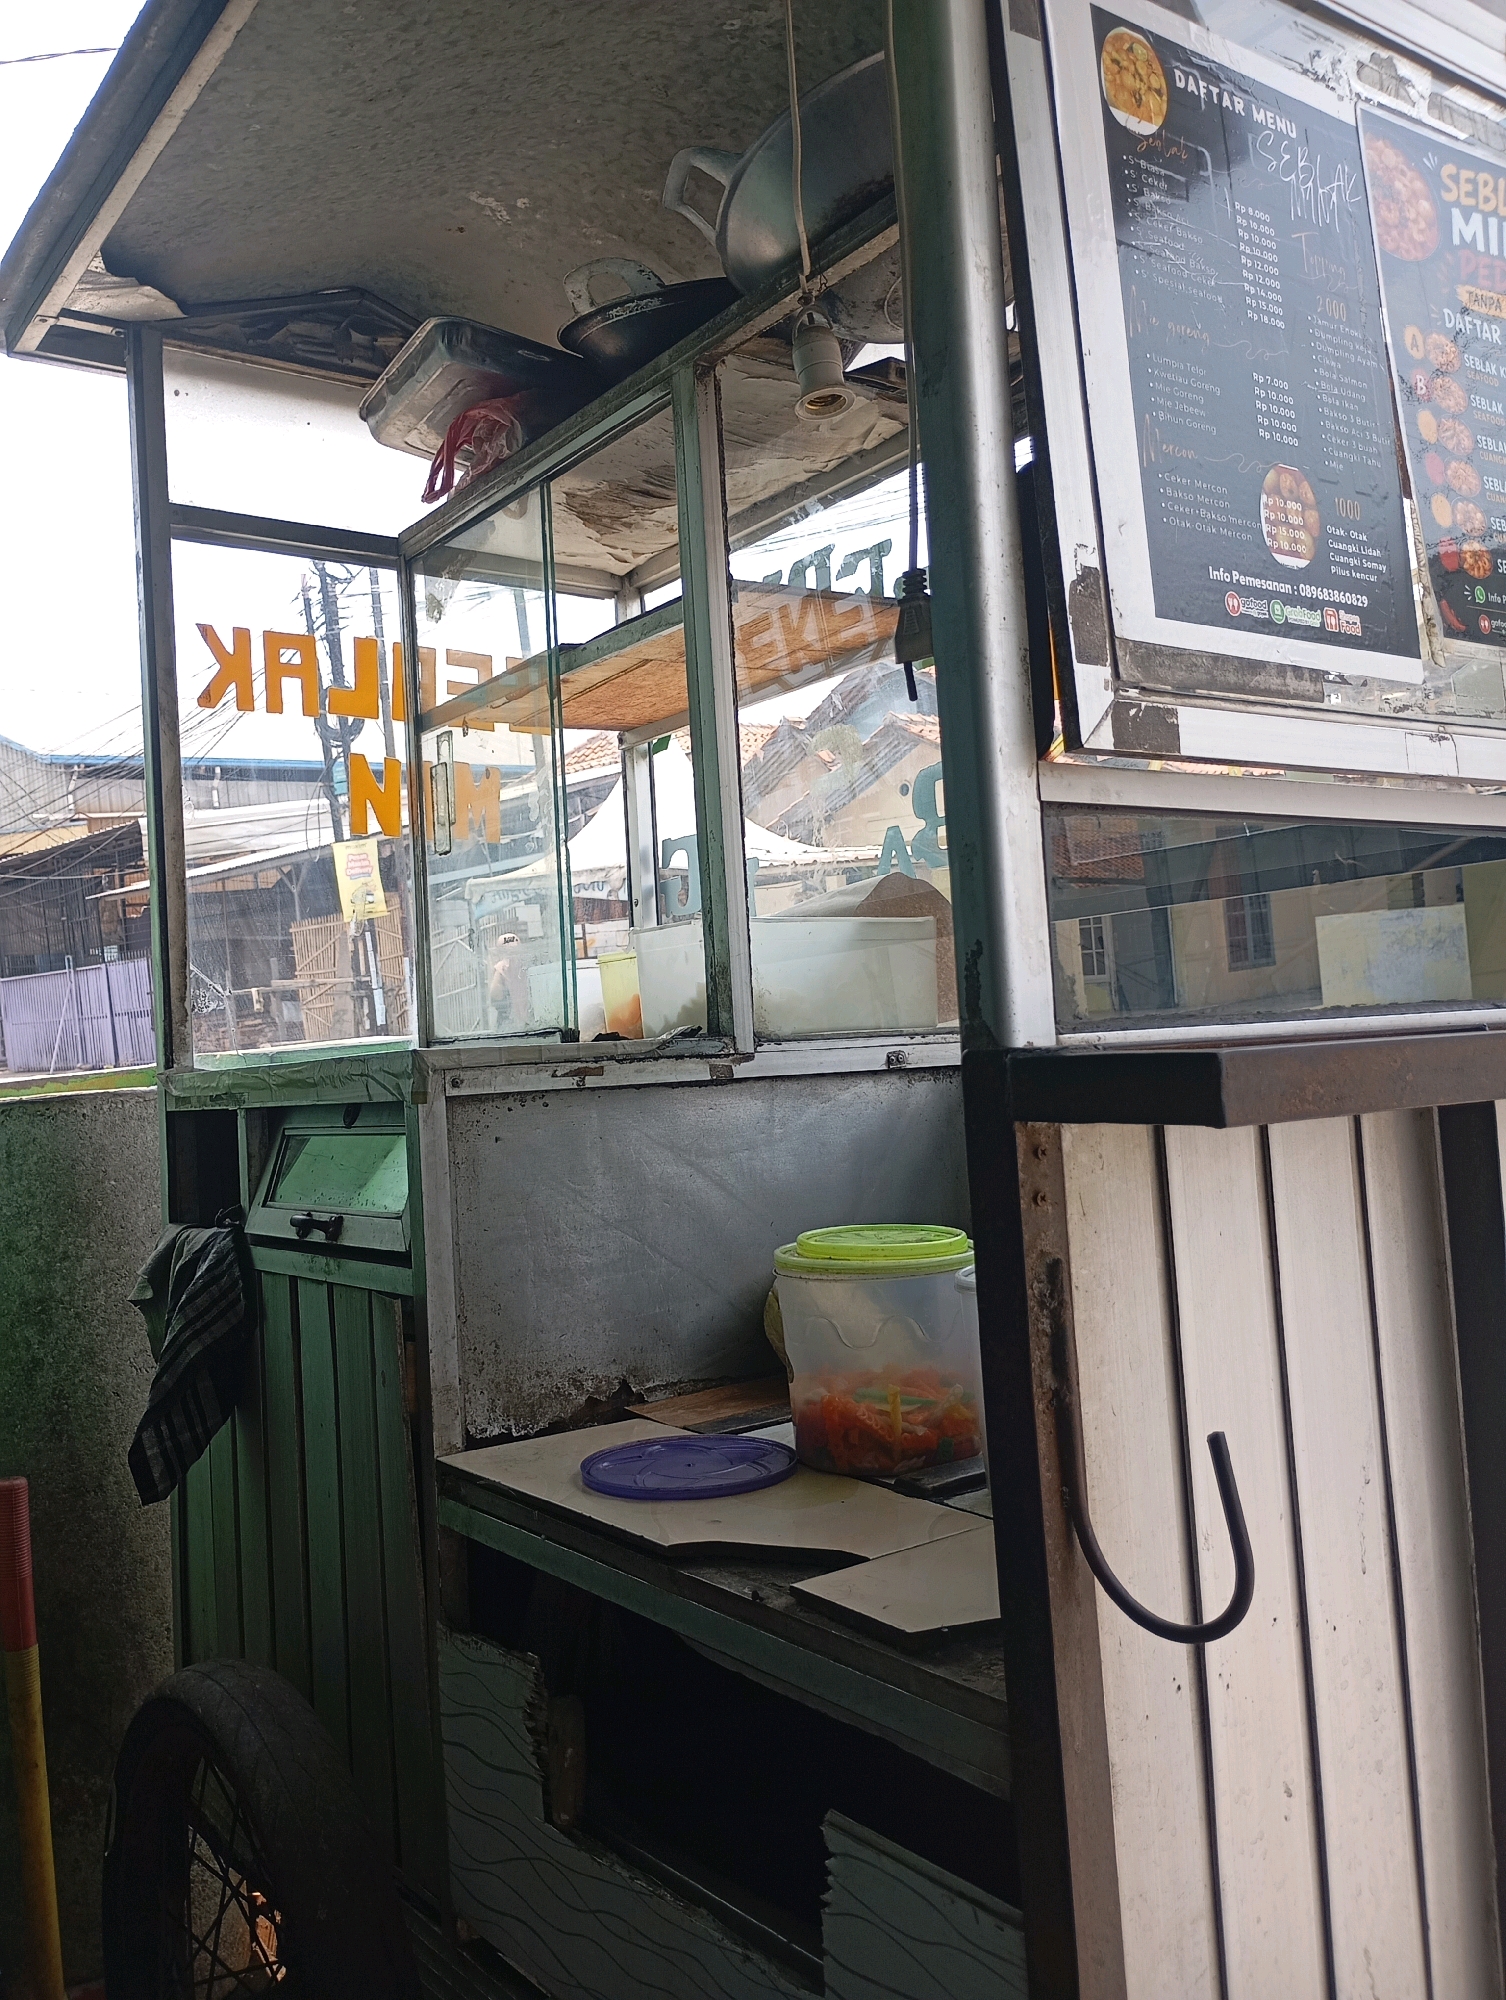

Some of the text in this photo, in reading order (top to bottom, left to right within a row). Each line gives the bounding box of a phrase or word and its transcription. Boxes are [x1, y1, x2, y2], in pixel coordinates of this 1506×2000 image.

[1173, 68, 1297, 138] DAFTAR MENU
[1140, 159, 1165, 176] Biasa
[1257, 131, 1362, 202] SEBLAK
[1141, 174, 1168, 190] Ceker
[1143, 188, 1171, 205] Bakso
[1145, 202, 1172, 217] Bakso
[1235, 201, 1270, 223] Rp 8.000
[1146, 217, 1174, 232] Ceker
[1176, 226, 1203, 243] Bakso
[1236, 215, 1275, 236] Rp 10.000
[1451, 207, 1506, 259] MI
[1148, 230, 1185, 251] Seafood
[1238, 228, 1277, 250] Rp 10.000
[1239, 242, 1278, 263] Rp 10.000
[1151, 259, 1188, 278] Seafood
[1189, 259, 1215, 275] Bakso
[1241, 255, 1279, 276] Rp 12.000
[1152, 273, 1186, 291] Spesial
[1242, 269, 1280, 289] Rp 12.000
[1244, 283, 1282, 303] Rp 14.000
[1465, 290, 1502, 312] TANPA
[1246, 296, 1283, 316] Rp 15.000
[1316, 295, 1346, 322] 2000
[1247, 310, 1285, 329] Rp 18.000
[1313, 315, 1362, 339] Jamur Enoki
[1443, 308, 1502, 345] DAFTAR
[1166, 322, 1210, 351] goreng
[1314, 328, 1354, 350] Dumpling
[1410, 333, 1419, 352] A
[1152, 352, 1206, 376] Lumpia Telor
[1315, 342, 1378, 369] Dumpling Ayam
[1317, 354, 1341, 369] Cikwa
[1463, 354, 1506, 378] SEBLAK K
[1154, 368, 1221, 396] Kwetiau Goreng
[1252, 372, 1289, 390] Rp 7.000
[1319, 367, 1368, 389] Bola Salmon
[1416, 374, 1426, 395] B
[1467, 369, 1499, 387] SEAFOOD
[1155, 382, 1204, 404] Mie Goreng
[1254, 386, 1294, 405] Rp 10.000
[1320, 380, 1366, 402] Bola Udang
[1156, 396, 1206, 417] Mie Jebeew
[1255, 400, 1296, 419] Rp 10.000
[1322, 393, 1359, 411] Bola Ikan
[1470, 394, 1504, 415] SEBLAK
[1158, 410, 1217, 436] Bihun Goreng
[1257, 414, 1297, 433] Rp 10.000
[1323, 407, 1375, 427] Bakso 3 Butir
[1473, 409, 1506, 426] SEAFOOD
[1143, 413, 1198, 468] Mercon
[1258, 428, 1299, 447] Rp 10.000
[1325, 420, 1391, 445] Bakso Aci 3 Butir
[1326, 434, 1378, 454] Ceker 3 buah
[1328, 447, 1381, 468] Cuangki Tahu
[1329, 460, 1344, 470] Mie
[1164, 473, 1228, 494] Ceker Mercon
[1483, 475, 1506, 494] SEBL
[1166, 487, 1230, 508] Bakso Mercon
[1275, 497, 1302, 511] 10.000
[1277, 511, 1304, 526] 10.000
[1335, 497, 1360, 521] 1000
[1220, 527, 1253, 541] Mercon
[1278, 526, 1305, 540] 15.000
[1349, 530, 1368, 542] Otak
[1279, 540, 1307, 554] 10.000
[1328, 539, 1382, 558] Cuangki Lidah
[1329, 552, 1387, 573] Cuangki Somay
[1330, 565, 1378, 582] Pilus kencur
[1208, 566, 1231, 582] Info
[1232, 571, 1292, 595] Pemesanan
[1299, 583, 1368, 607] 089683860829
[1240, 597, 1267, 609] gofood
[1488, 592, 1501, 604] Info
[1286, 602, 1320, 621] GrabFood
[1341, 622, 1361, 635] Food
